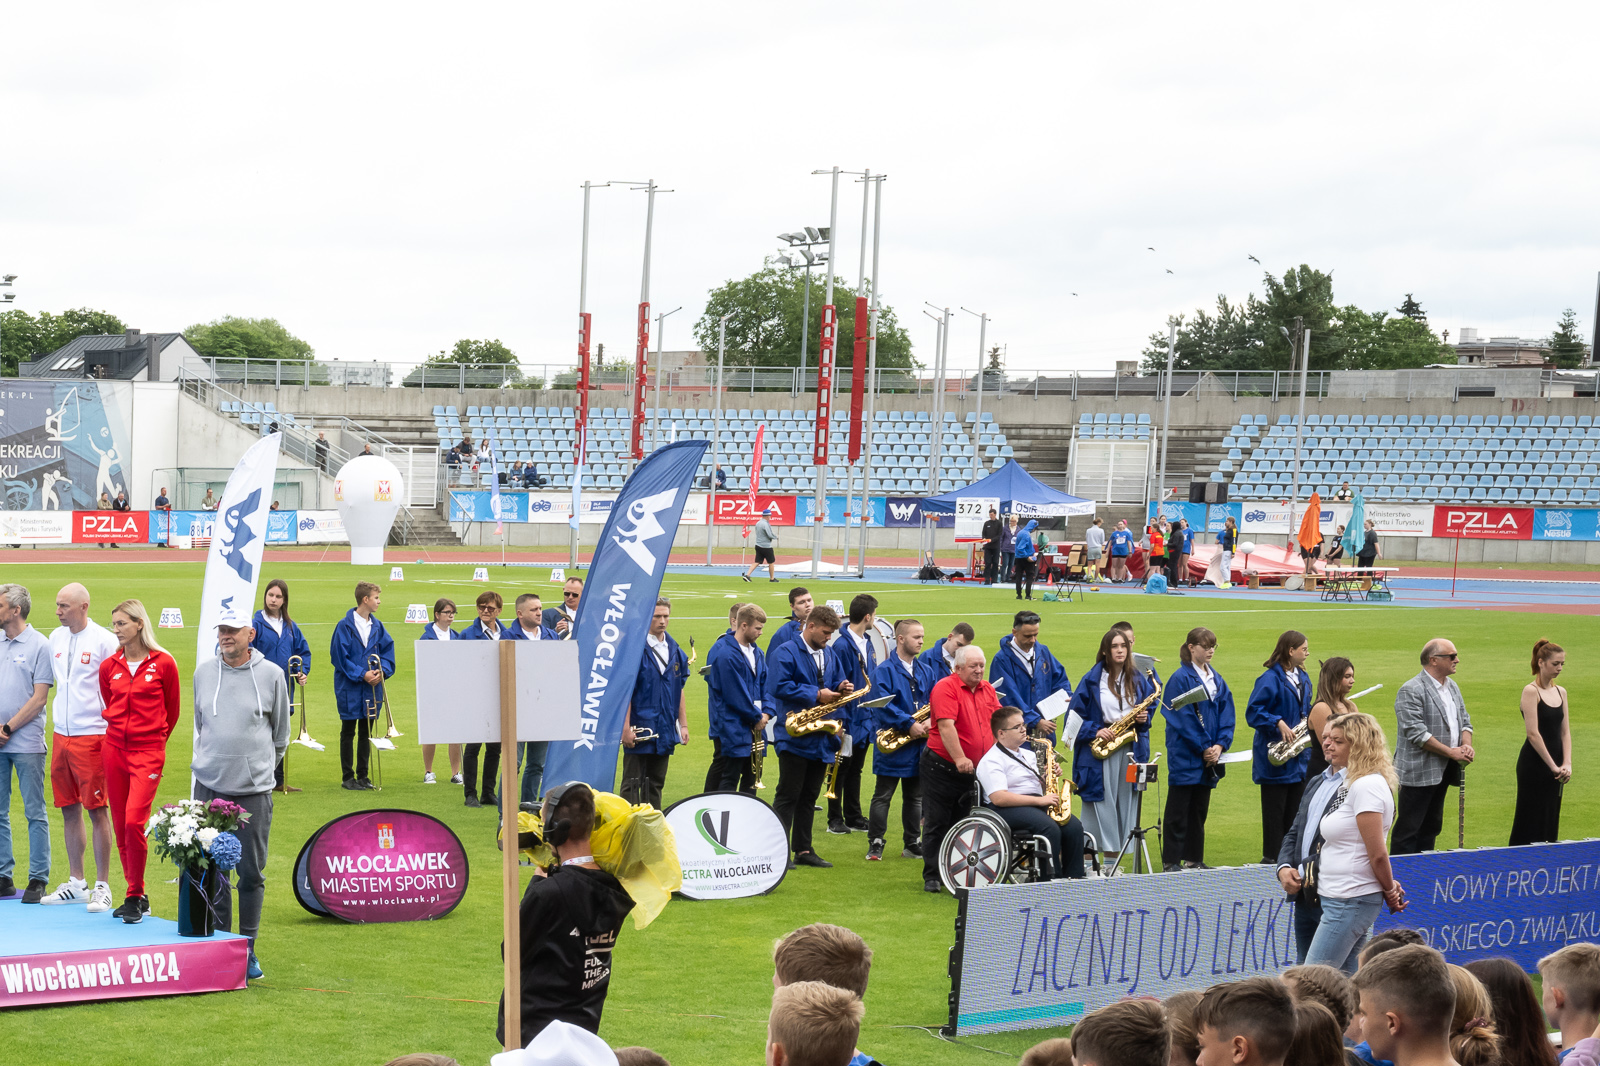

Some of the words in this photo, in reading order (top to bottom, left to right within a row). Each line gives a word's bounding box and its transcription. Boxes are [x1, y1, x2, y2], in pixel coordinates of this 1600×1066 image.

[1369, 510, 1412, 518] Ministerstwo
[1446, 511, 1518, 529] PZLA
[82, 516, 139, 533] PZLA
[1395, 519, 1425, 527] Turystyki
[20, 526, 38, 534] Sportu
[1543, 529, 1572, 538] Nestlé
[392, 571, 402, 579] 16
[474, 571, 483, 580] 14
[551, 571, 561, 580] 12
[160, 612, 170, 625] 35
[170, 612, 182, 625] 35
[406, 609, 416, 620] 30
[417, 609, 428, 620] 30
[573, 582, 632, 752] WŁOCŁAWEK
[325, 852, 451, 874] WŁOCŁAWEK
[714, 863, 773, 879] WŁOCŁAWEK
[320, 876, 393, 894] MIASTEM
[395, 873, 458, 893] SPORTU
[1433, 871, 1502, 905] NOWY
[1505, 864, 1593, 898] PROJEKT
[342, 893, 441, 906] www.wloclawek.pl
[1011, 907, 1151, 995] ZACZNIJ
[1159, 905, 1201, 981] OD
[1, 956, 124, 995] Włocławek
[127, 951, 181, 985] 2024
